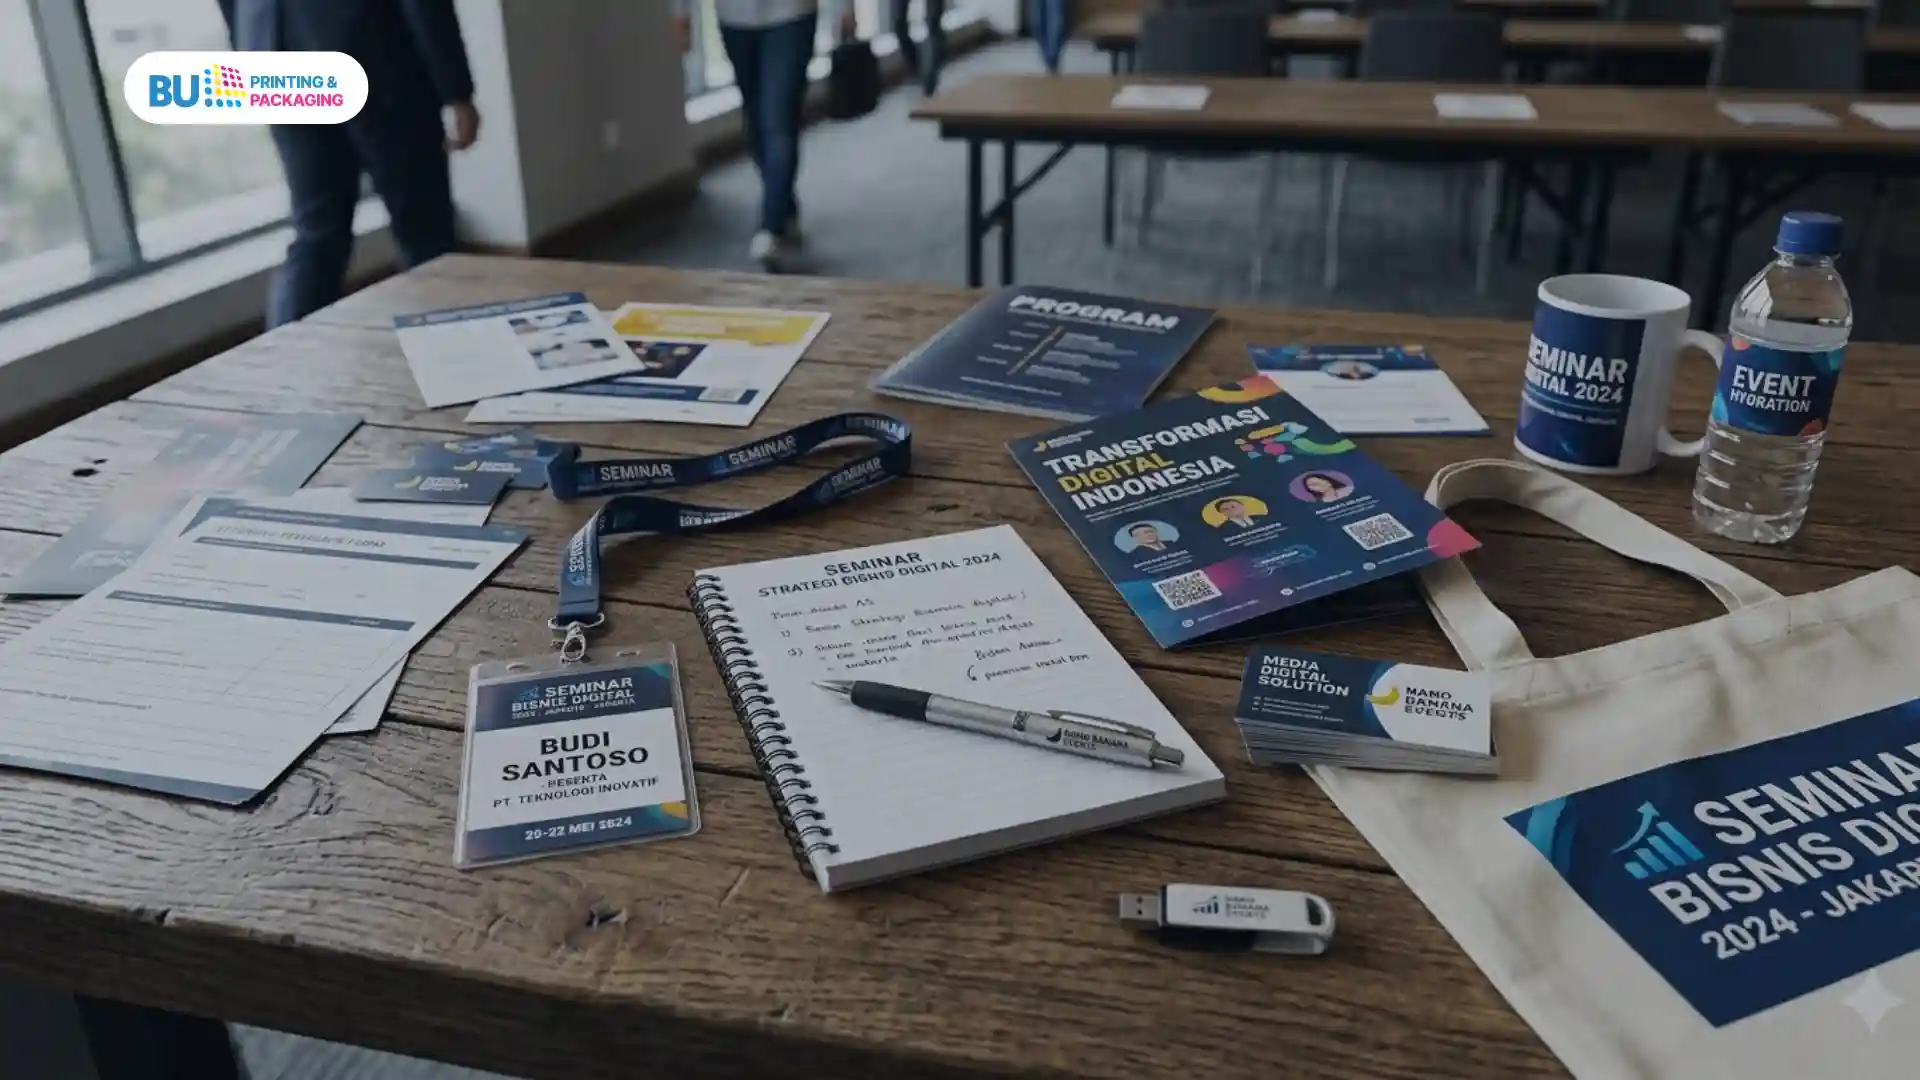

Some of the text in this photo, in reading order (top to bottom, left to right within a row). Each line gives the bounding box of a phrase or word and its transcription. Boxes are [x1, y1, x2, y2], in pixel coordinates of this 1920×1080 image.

[1008, 294, 1180, 330] PROGRAM
[1574, 382, 1624, 403] 2024
[1732, 364, 1817, 397] EVENT
[1043, 405, 1271, 475] TRANSFORMASI
[600, 463, 674, 482] SEMINAR
[1058, 452, 1176, 493] DIGITAL
[1070, 455, 1236, 511] INDONESIA
[758, 577, 838, 597] STRATEGI
[898, 559, 960, 577] DIGITAL
[824, 552, 923, 576] SEMINAR
[1260, 664, 1330, 684] DIGITAL
[1263, 655, 1320, 672] MEDIA
[545, 677, 633, 698] SEMINAR
[1258, 675, 1350, 697] SOLUTION
[540, 731, 610, 755] BUDI
[502, 747, 649, 782] SANTOSO
[598, 776, 660, 793] INOVATIF
[1693, 742, 1920, 846] SEMINA
[568, 821, 594, 835] MEI
[1648, 831, 1856, 925] BISNIS
[1700, 907, 1800, 960] 2024
